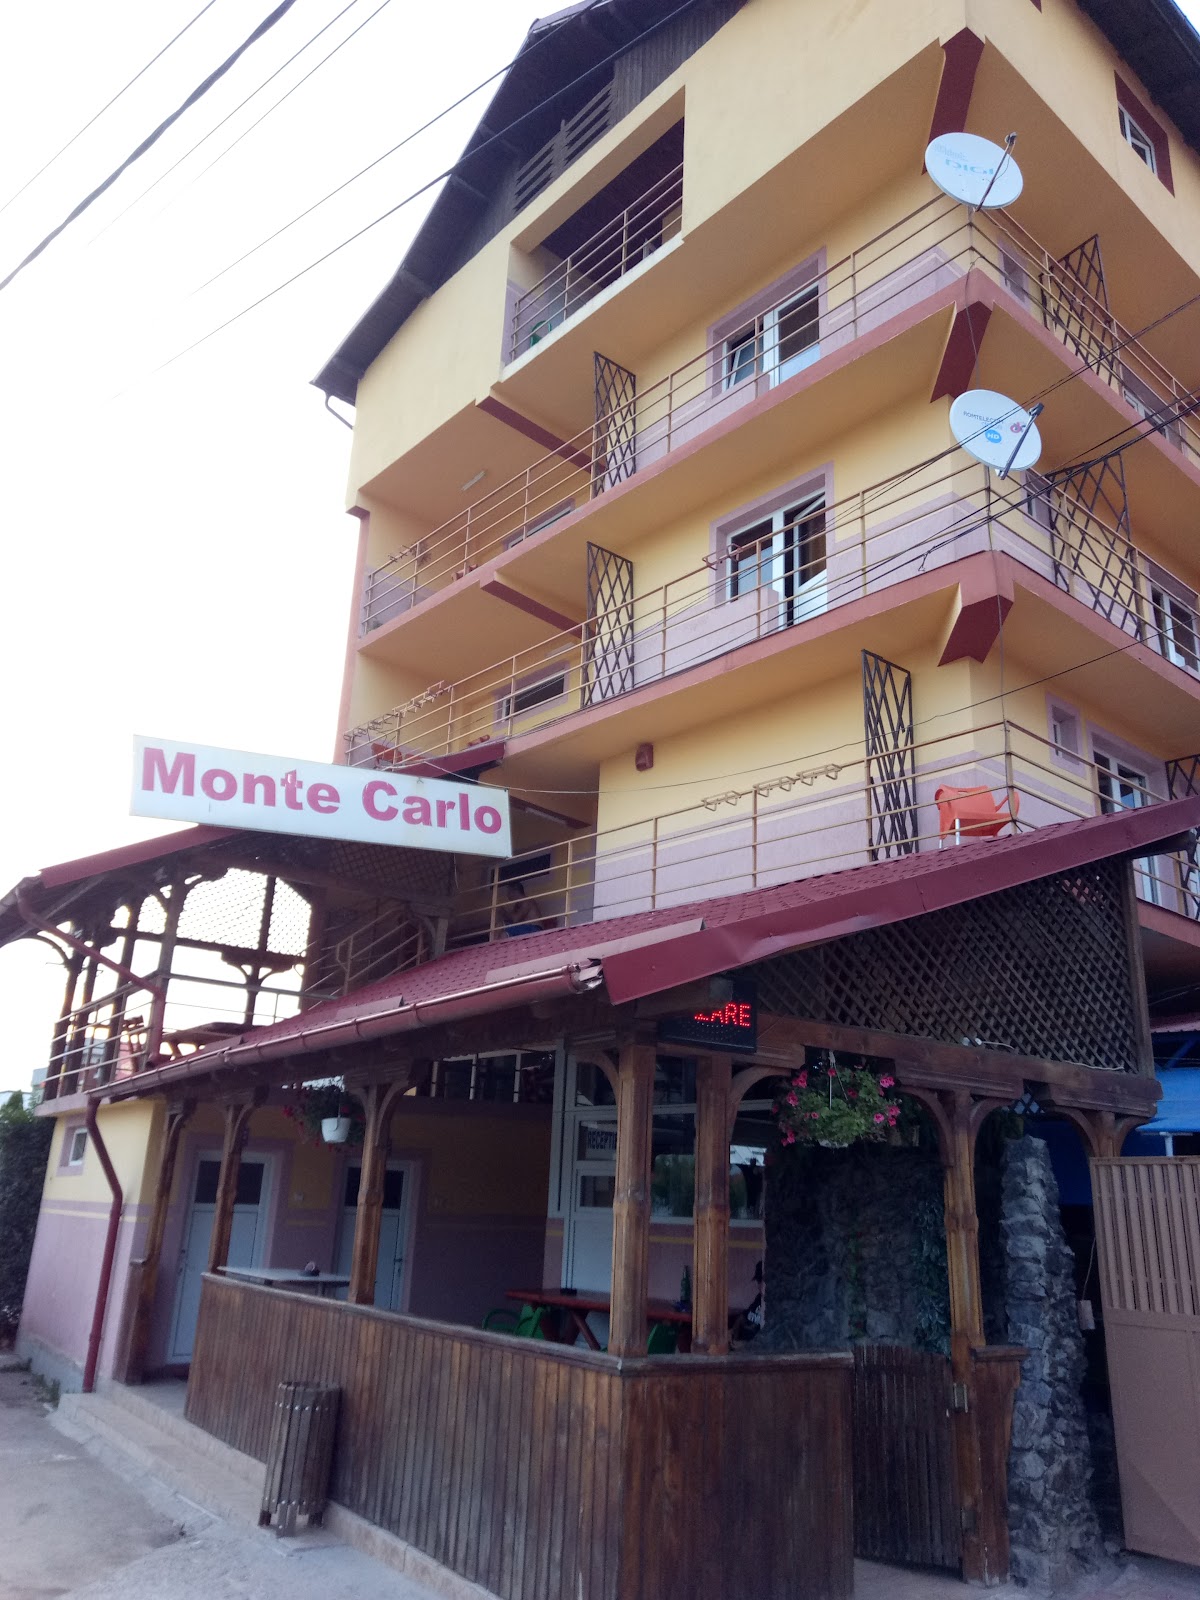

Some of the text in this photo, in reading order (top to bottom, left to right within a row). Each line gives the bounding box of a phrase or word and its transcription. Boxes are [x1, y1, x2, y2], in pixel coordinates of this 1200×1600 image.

[987, 432, 1000, 440] HD
[141, 747, 502, 834] Monte Carlo
[587, 1130, 617, 1150] RECEPTI
